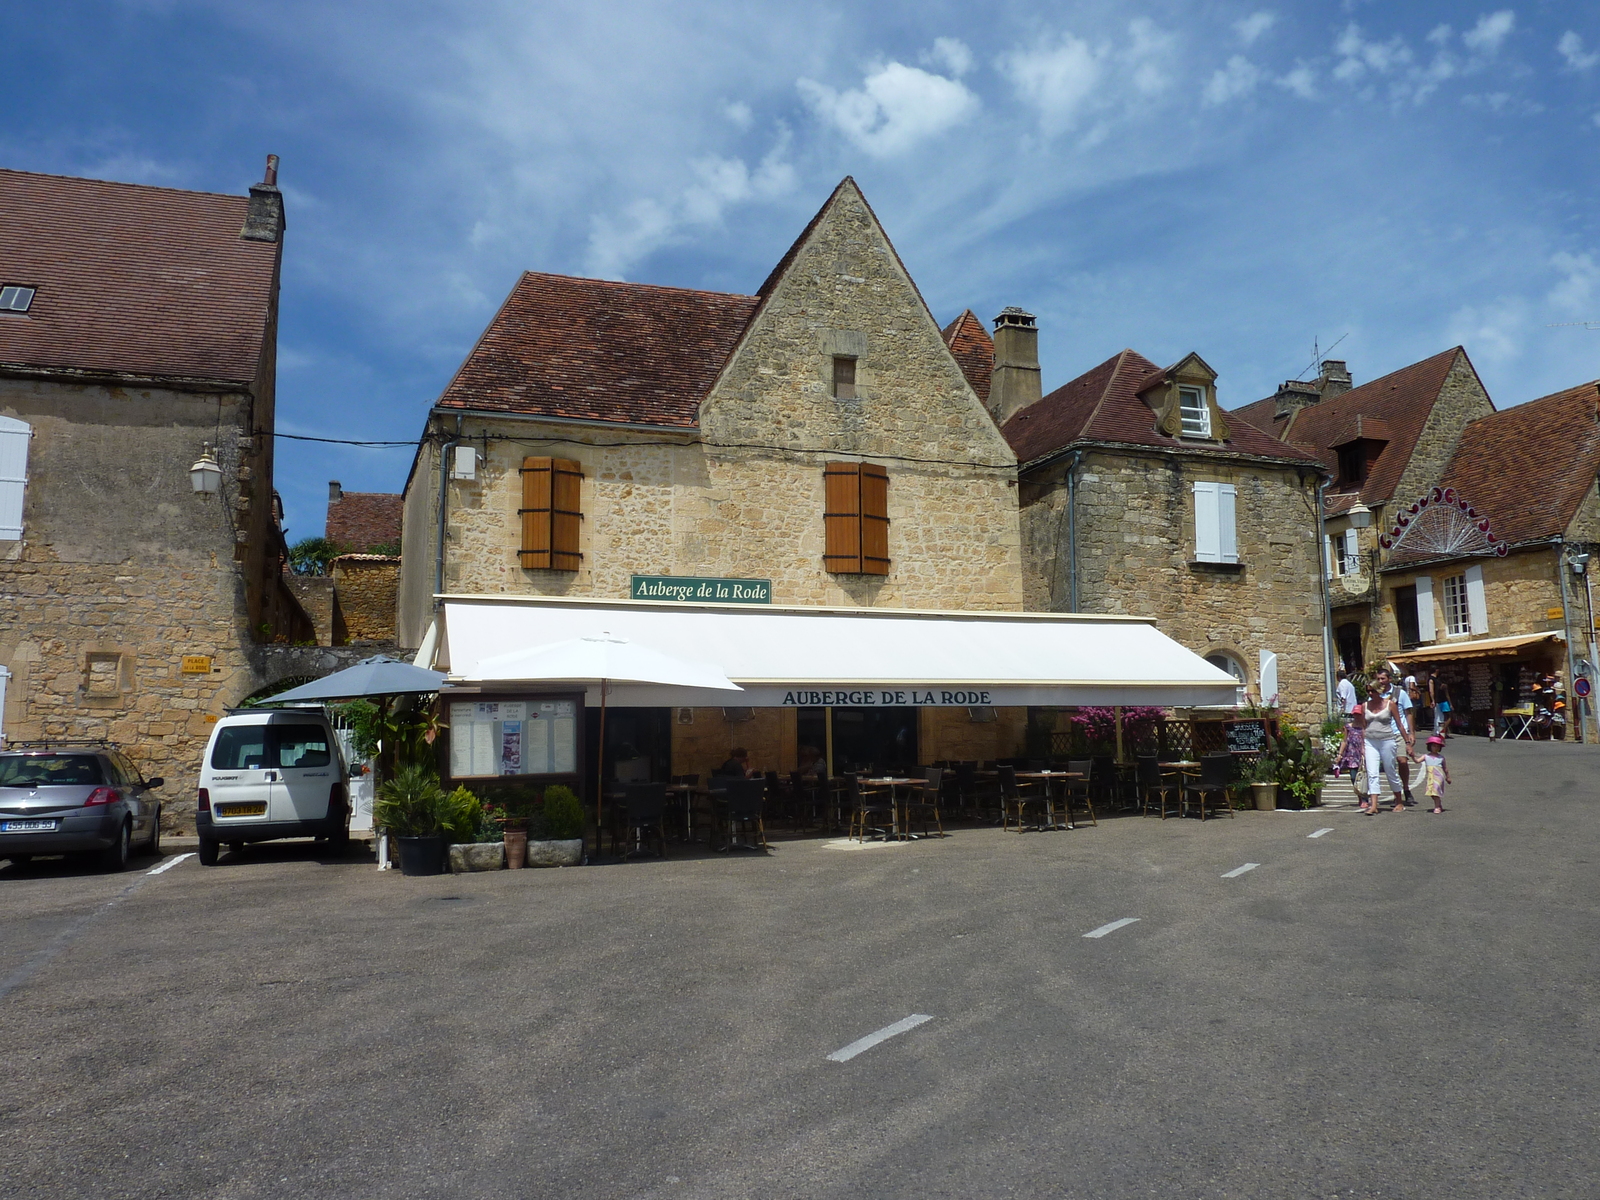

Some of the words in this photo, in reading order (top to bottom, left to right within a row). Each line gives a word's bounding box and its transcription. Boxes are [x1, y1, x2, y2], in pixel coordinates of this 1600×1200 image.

[636, 581, 694, 601] Auberge
[696, 583, 713, 598] de
[716, 584, 729, 598] la
[732, 584, 767, 599] Rode
[782, 691, 875, 705] AUBERGE
[881, 691, 906, 705] DE
[912, 691, 936, 705] LA
[940, 691, 992, 705] RODE
